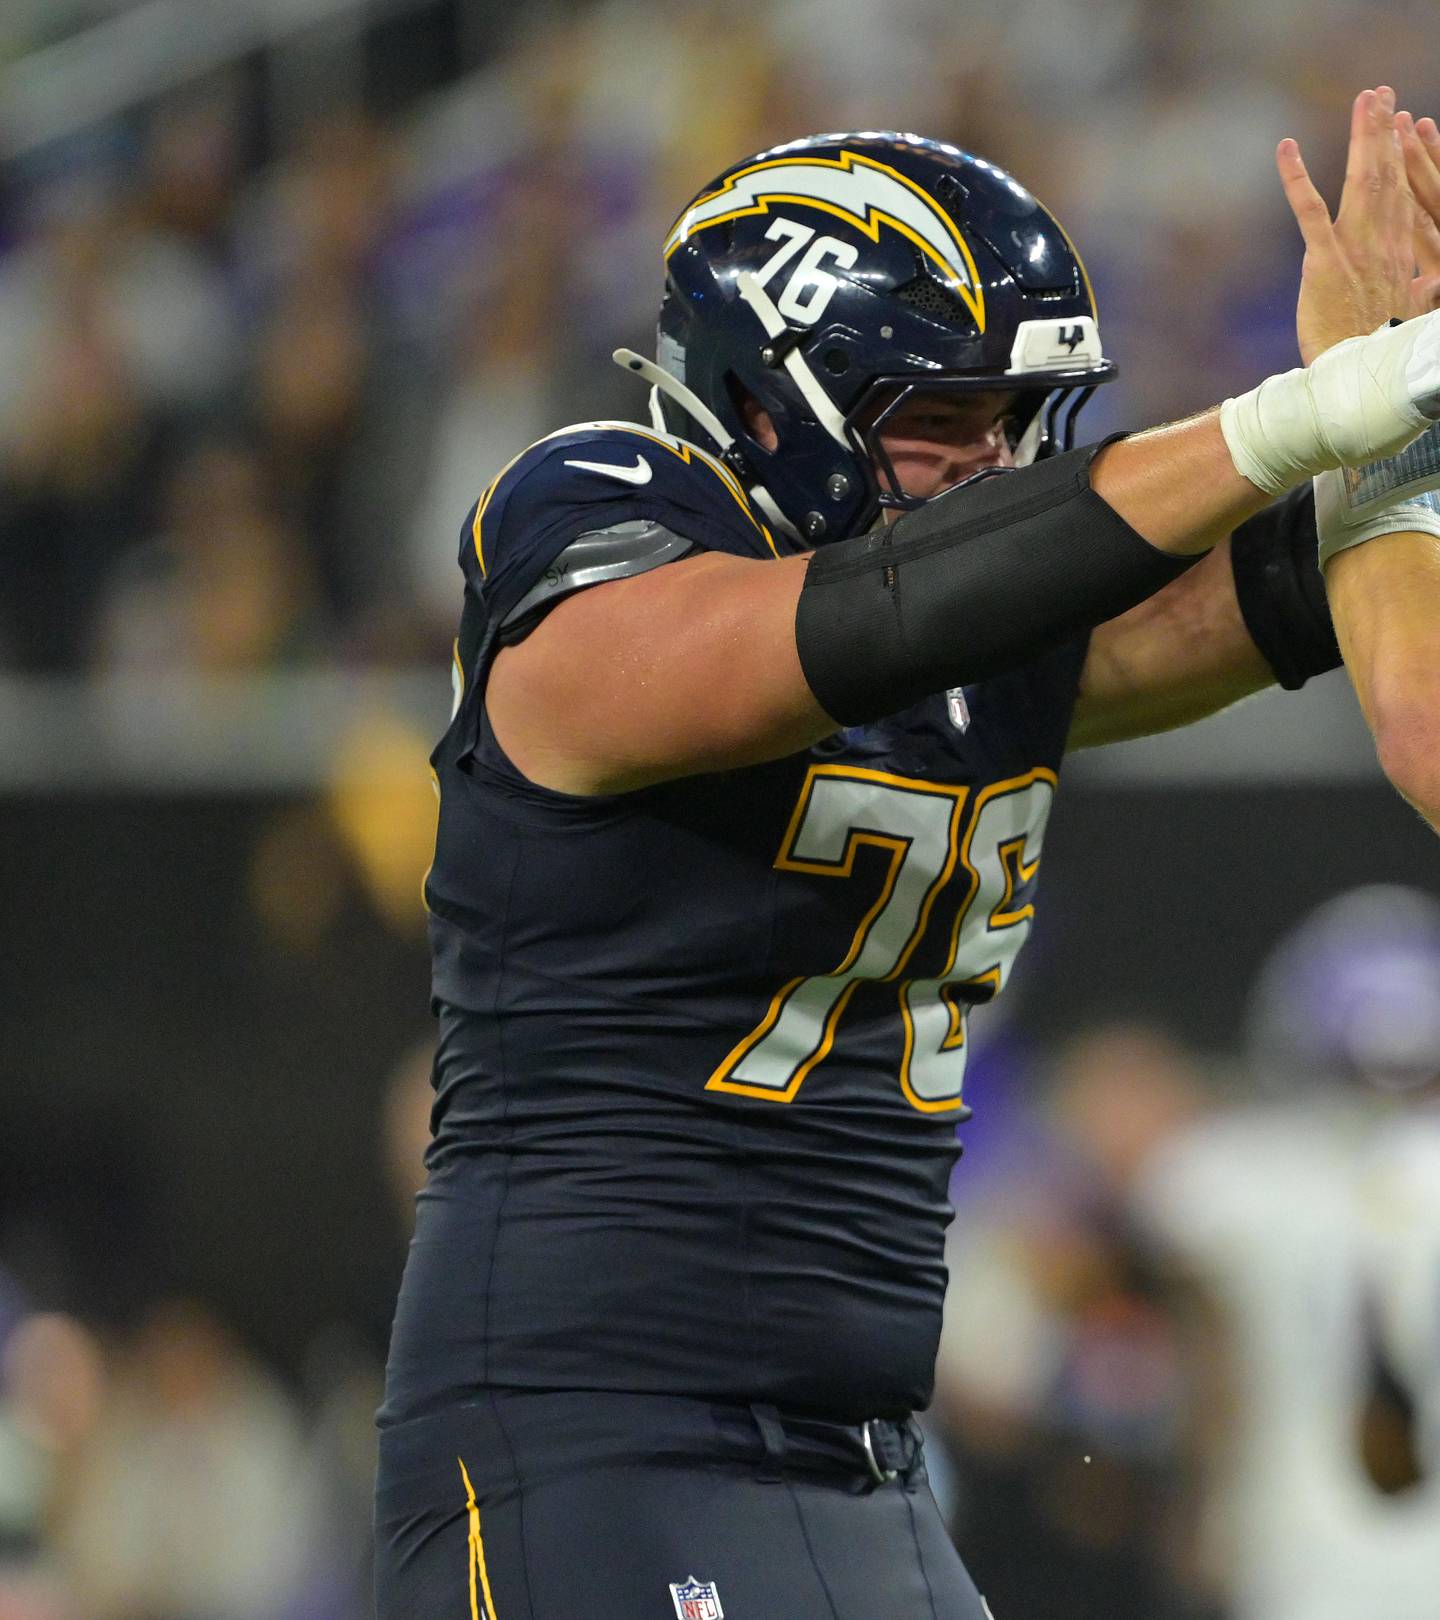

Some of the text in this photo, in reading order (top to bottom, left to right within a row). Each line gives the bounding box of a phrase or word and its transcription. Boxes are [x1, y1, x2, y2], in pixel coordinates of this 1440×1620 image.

[764, 217, 859, 324] 76
[704, 764, 1058, 1113] 76
[683, 1600, 715, 1620] NFL
